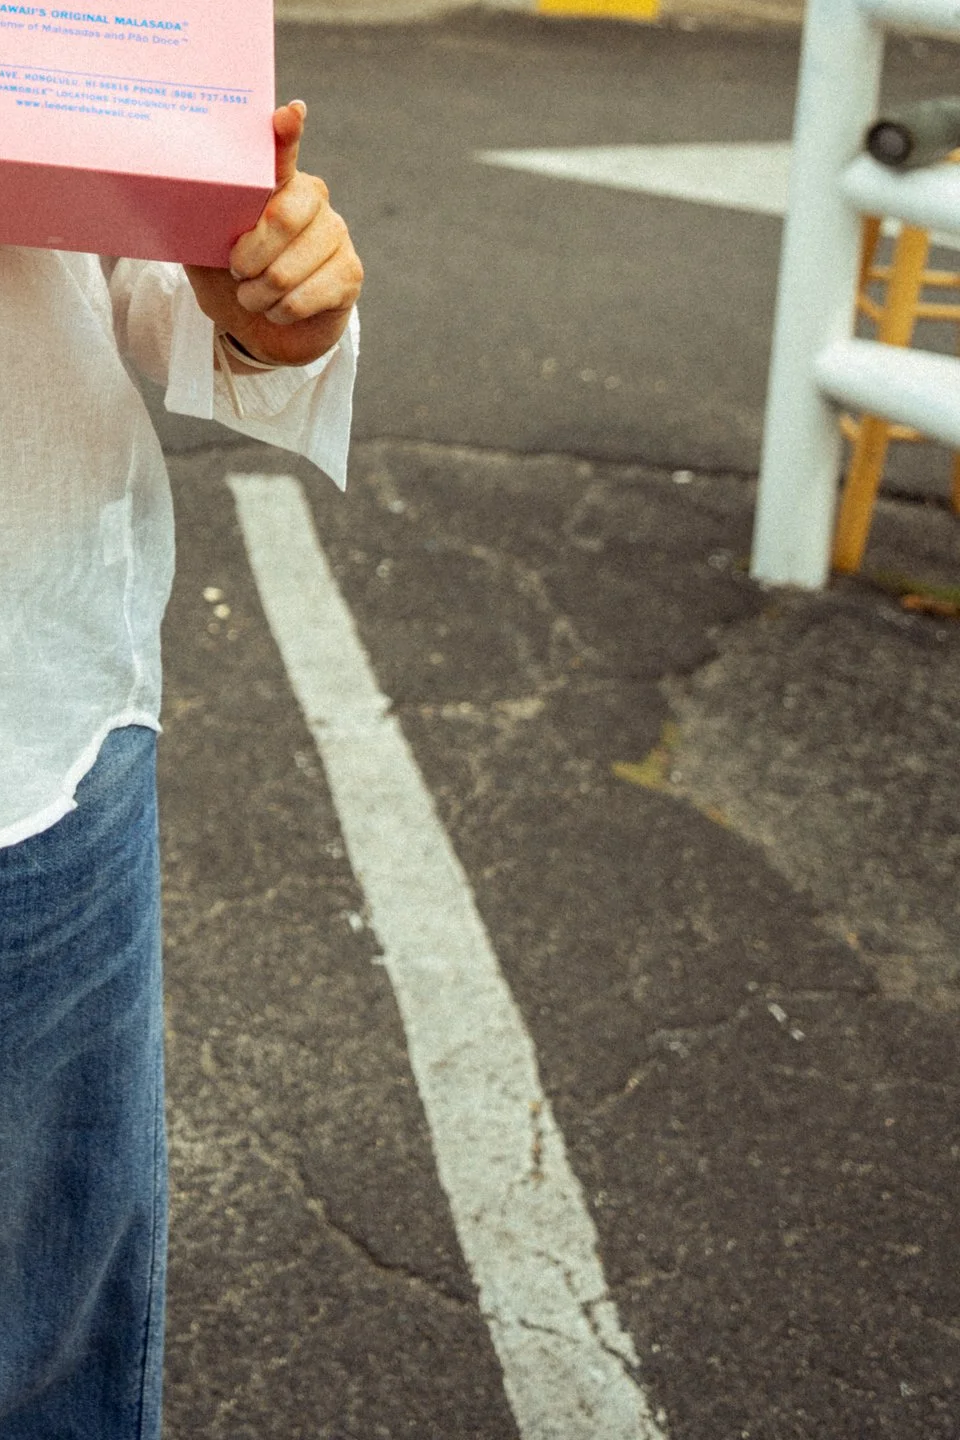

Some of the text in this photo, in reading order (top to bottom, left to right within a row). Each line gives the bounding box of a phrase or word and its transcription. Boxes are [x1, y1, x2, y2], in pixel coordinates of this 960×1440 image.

[51, 9, 109, 24] ORIGINAL
[114, 15, 182, 31] MALASADA
[27, 23, 39, 31] of
[42, 23, 101, 38] Malasadas
[103, 30, 125, 41] and
[152, 35, 180, 46] Doce
[133, 85, 167, 97] PHONE
